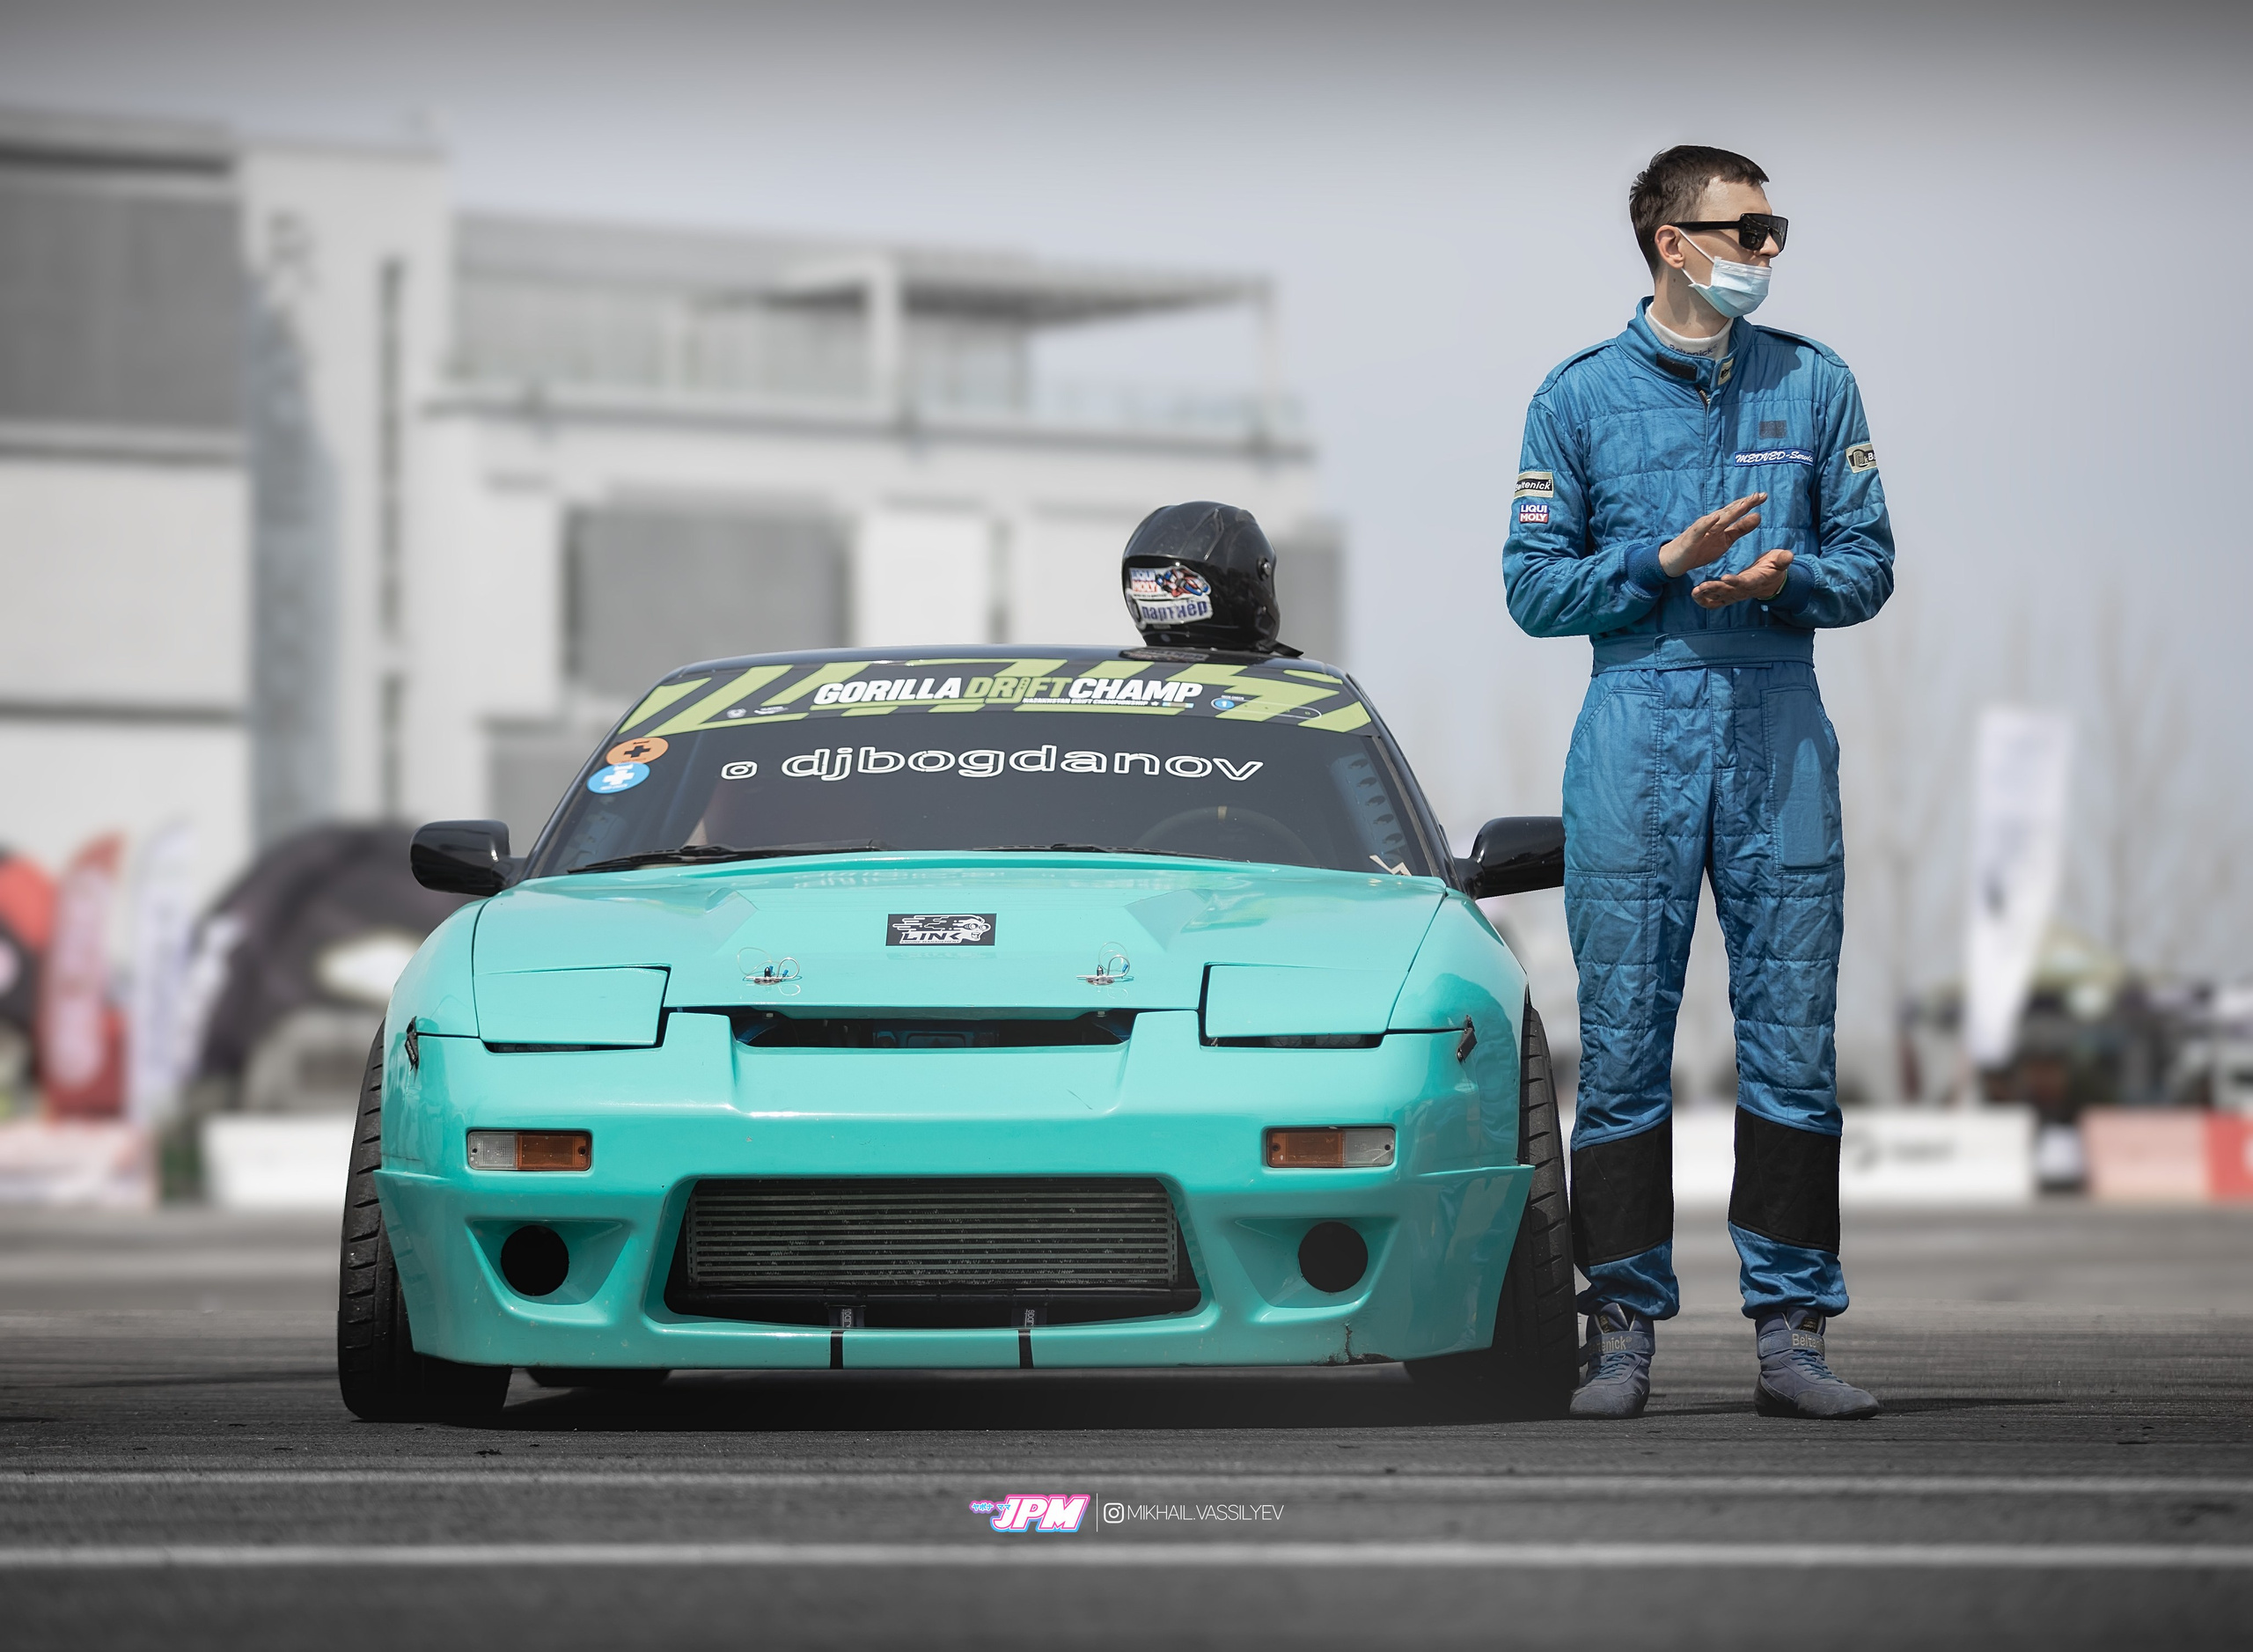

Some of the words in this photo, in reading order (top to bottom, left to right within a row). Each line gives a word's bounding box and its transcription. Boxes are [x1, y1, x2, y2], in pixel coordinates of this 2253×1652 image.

[1521, 504, 1548, 513] LIQUI
[1520, 513, 1548, 522] MOLY
[1132, 581, 1158, 592] MOLY
[813, 677, 962, 705] GORILLA
[963, 676, 1073, 704] DRIFT
[1068, 678, 1203, 702] CHAMP
[782, 745, 1264, 781] djbogdanov
[902, 932, 961, 941] LINK
[1024, 1309, 1035, 1328] spar
